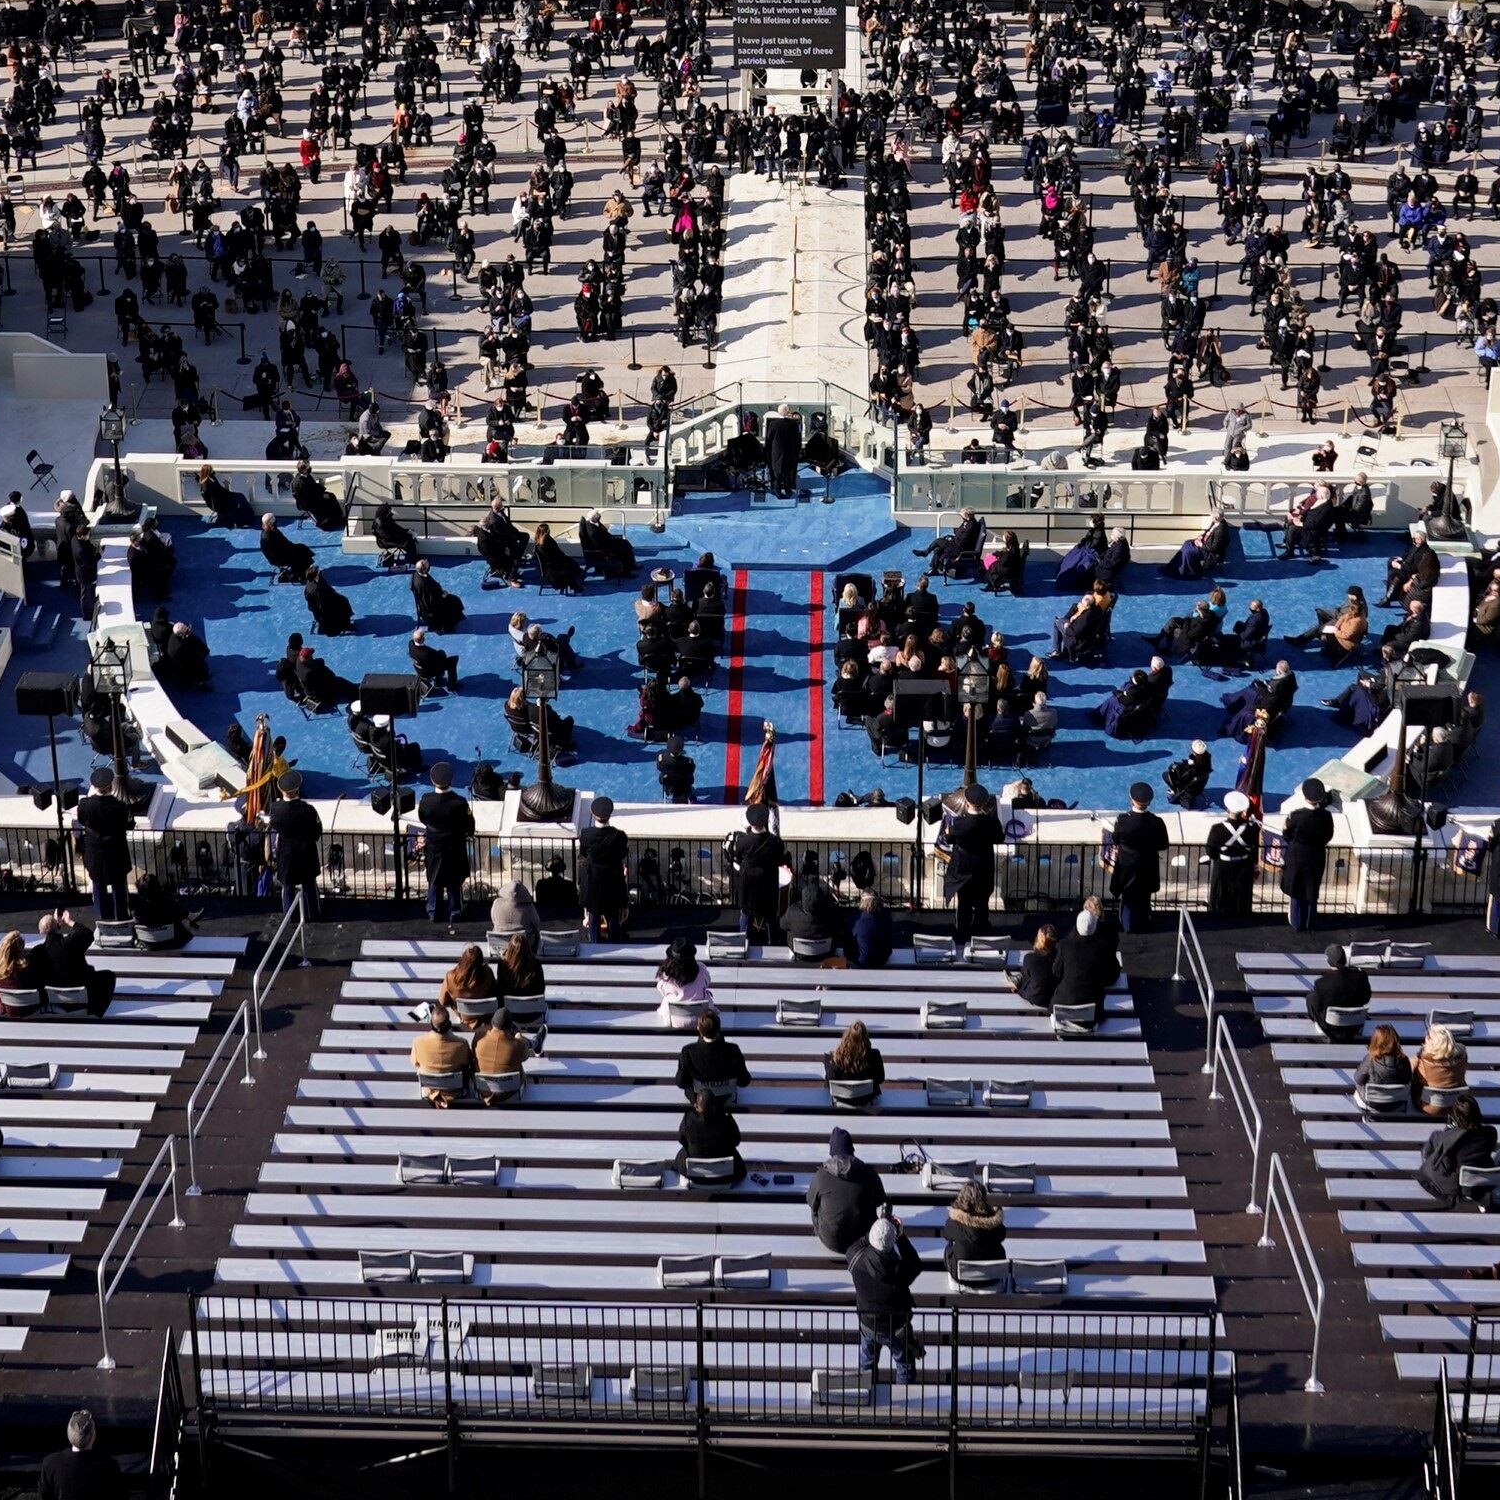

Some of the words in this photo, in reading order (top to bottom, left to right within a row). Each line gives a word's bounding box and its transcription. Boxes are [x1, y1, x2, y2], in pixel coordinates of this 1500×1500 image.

[737, 6, 760, 15] today,
[814, 6, 837, 15] salute
[761, 37, 776, 46] just
[783, 47, 801, 56] each
[386, 1331, 420, 1340] RENTED
